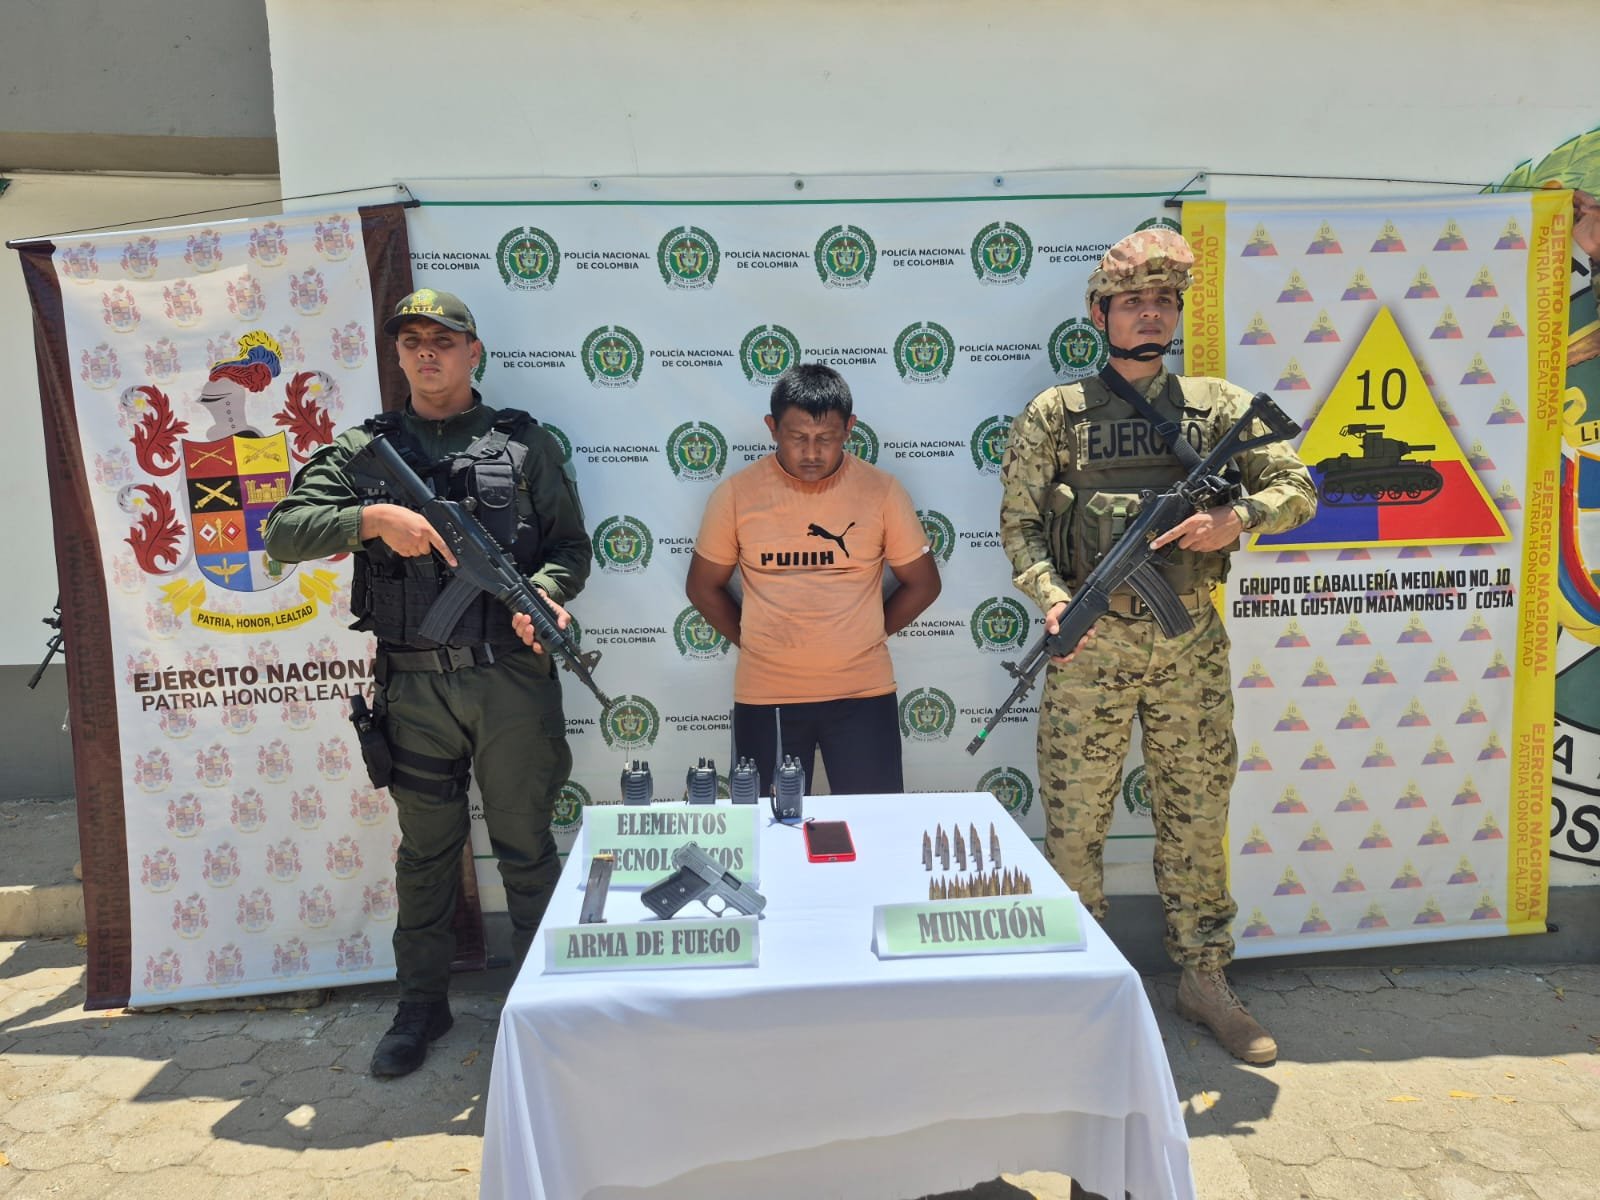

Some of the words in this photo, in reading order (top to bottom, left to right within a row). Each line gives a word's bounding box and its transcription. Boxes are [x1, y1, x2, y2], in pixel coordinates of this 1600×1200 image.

[881, 248, 917, 257] POLICÍA
[918, 248, 966, 256] NACIONAL
[1037, 244, 1074, 254] POLICÍA
[1075, 243, 1113, 253] NACION
[1536, 225, 1550, 282] PATRIA
[408, 250, 441, 260] OLICÍA
[442, 251, 492, 260] NACIONAL
[564, 250, 601, 260] POLICÍA
[602, 251, 651, 260] NACIONAL
[724, 250, 761, 259] POLICÍA
[762, 250, 811, 260] NACIONAL
[1049, 255, 1062, 263] DE
[1063, 254, 1103, 262] COLOMB
[416, 262, 429, 271] DE
[430, 262, 481, 271] COLOMBIA
[576, 261, 589, 270] DE
[590, 261, 639, 270] COLOMBIA
[736, 261, 749, 269] DE
[750, 260, 799, 269] COLOMBIA
[893, 259, 905, 267] DE
[906, 258, 955, 267] COLOMBIA
[1551, 214, 1565, 314] EJERCITO
[1206, 235, 1219, 308] LEALTAD
[1191, 225, 1205, 337] NACIONAL
[402, 305, 444, 315] GAULA
[1537, 286, 1550, 345] HONOR
[959, 343, 994, 353] POLICÍA
[995, 343, 1043, 352] NACIONAL
[1206, 314, 1219, 372] HONOR
[490, 349, 527, 359] POLICÍA
[528, 350, 577, 358] NACIONAL
[649, 348, 686, 358] POLICÍA
[687, 349, 735, 357] NACIONAL
[804, 346, 840, 356] POLICÍA
[841, 347, 888, 355] NACIONAL
[816, 358, 828, 366] DE
[830, 357, 877, 365] COLOMBIA
[970, 354, 982, 362] DE
[984, 353, 1031, 362] COLOMBIA
[503, 361, 516, 369] DE
[517, 360, 566, 369] COLOMBIA
[661, 360, 674, 368] DE
[675, 359, 723, 368] COLOMBIA
[1546, 321, 1563, 432] NACIONAL
[1356, 368, 1406, 410] 10
[1536, 350, 1549, 420] LEALTAD
[1088, 418, 1203, 460] EJERCO
[575, 444, 612, 454] POLICÍA
[612, 445, 660, 454] NACIONAL
[883, 440, 919, 449] POLICÍA
[920, 440, 966, 448] NACIONAL
[587, 455, 600, 463] DE
[601, 455, 649, 463] COLOMBIA
[743, 454, 756, 462] DE
[895, 451, 907, 459] DE
[908, 450, 955, 458] COLOMBIA
[1529, 481, 1542, 537] PATRIA
[1539, 470, 1555, 567] EJERCITO
[970, 540, 982, 548] DE
[1525, 540, 1539, 596] HONOR
[1240, 576, 1289, 595] GRUPO
[1293, 575, 1311, 593] DE
[1313, 569, 1398, 593] CABALLERÍA
[1401, 571, 1466, 590] MEDIANO
[1469, 570, 1492, 588] NO.
[1495, 568, 1511, 586] 10
[1233, 598, 1297, 618] GENERAL
[1300, 596, 1363, 616] GUSTAVO
[1366, 593, 1454, 613] MATAMOROS
[197, 612, 234, 629] PATRIA,
[236, 616, 274, 628] HONOR,
[275, 605, 313, 625] LEALTAD
[921, 620, 966, 628] NACIONAL
[1534, 573, 1550, 677] NACIONAL
[584, 626, 620, 636] POLICÍA
[621, 627, 667, 635] NACIONAL
[896, 629, 908, 638] DE
[910, 629, 955, 637] COLOMBIA
[1523, 600, 1536, 667] LEALTAD
[596, 637, 609, 645] DE
[609, 636, 656, 644] COLOMBIA
[133, 665, 258, 693] EJÉRCITO
[267, 658, 377, 683] NACIONA
[142, 693, 217, 711] PATRIA
[222, 688, 298, 707] HONOR
[304, 682, 377, 702] LEALTA
[960, 706, 993, 715] POLICÍA
[665, 714, 699, 723] POLICÍA
[701, 714, 732, 722] NACIO
[970, 716, 981, 724] DE
[676, 724, 688, 732] DE
[1518, 734, 1530, 786] PATRIA
[1530, 723, 1546, 816] EJERCITO
[1517, 789, 1529, 844] HONOR
[617, 812, 727, 836] ELEMENTOS
[1527, 821, 1545, 920] NACIONAL
[1515, 848, 1529, 912] LEALTAD
[917, 902, 1046, 944] MUNICIÓN
[567, 933, 629, 959] ARMA
[636, 930, 664, 956] DE
[672, 927, 741, 955] FUEGO
